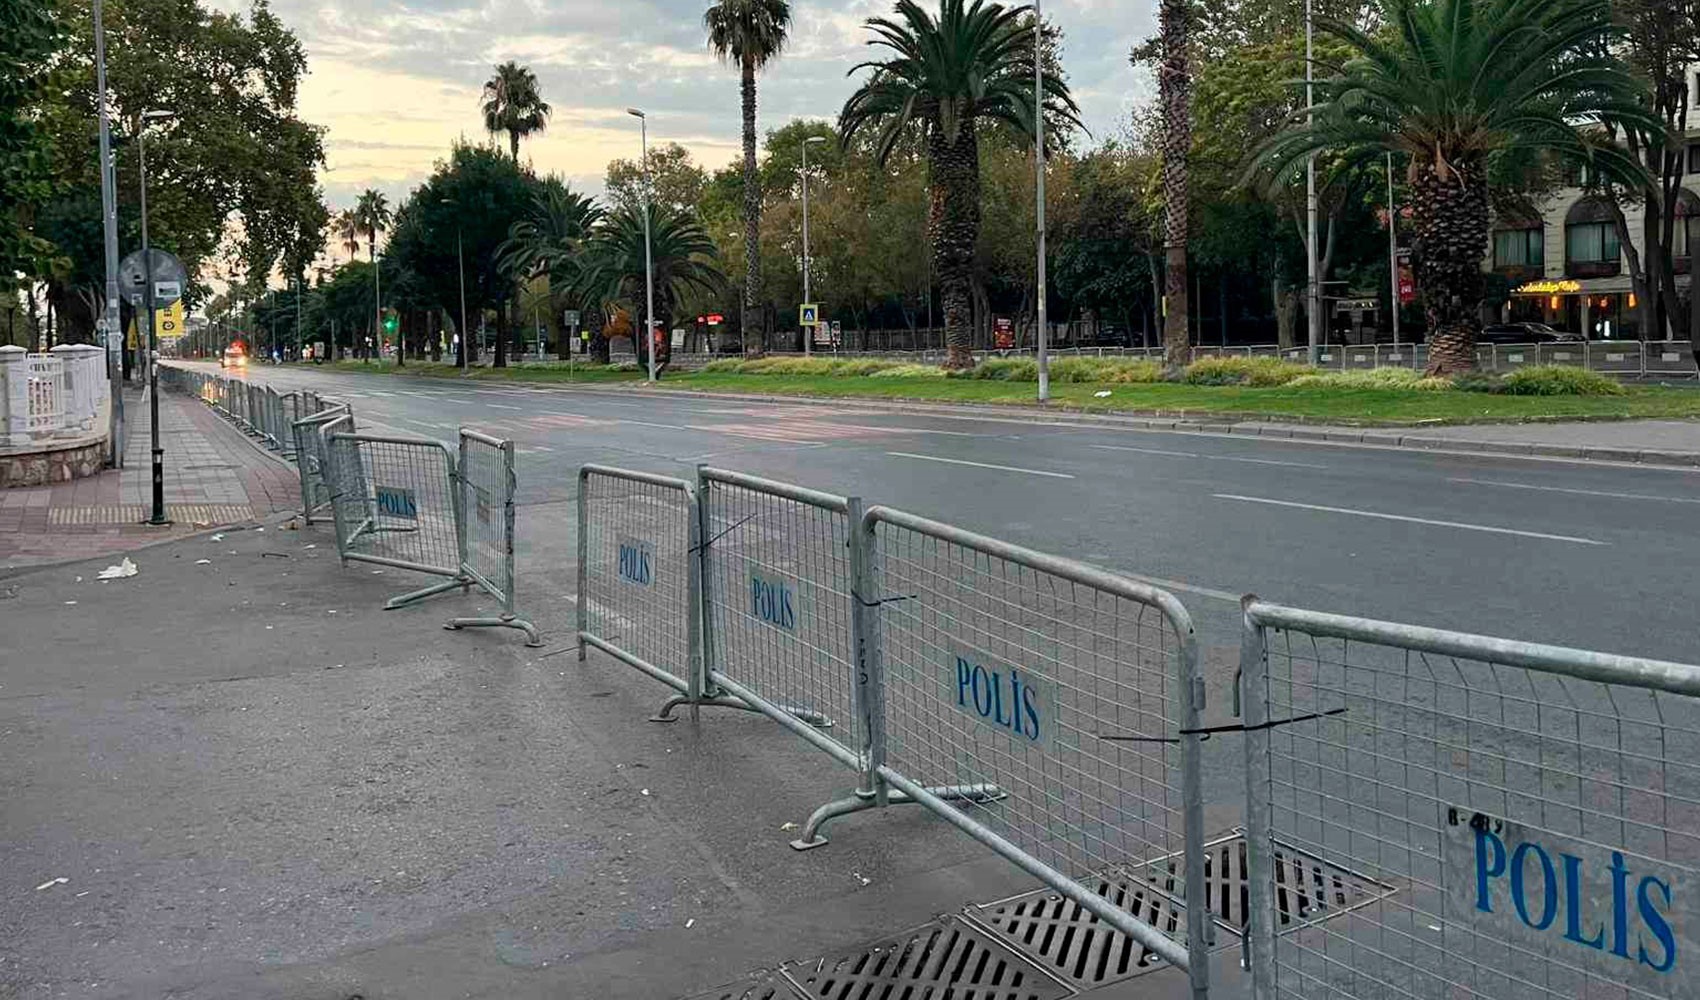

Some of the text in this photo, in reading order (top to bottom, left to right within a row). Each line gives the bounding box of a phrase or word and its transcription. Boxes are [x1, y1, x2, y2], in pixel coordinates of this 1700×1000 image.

[378, 488, 416, 516] POLİS
[619, 543, 651, 586] POLİS
[752, 577, 794, 631] POLİS
[956, 655, 1040, 741] POLİS
[1473, 830, 1676, 974] POLİS
